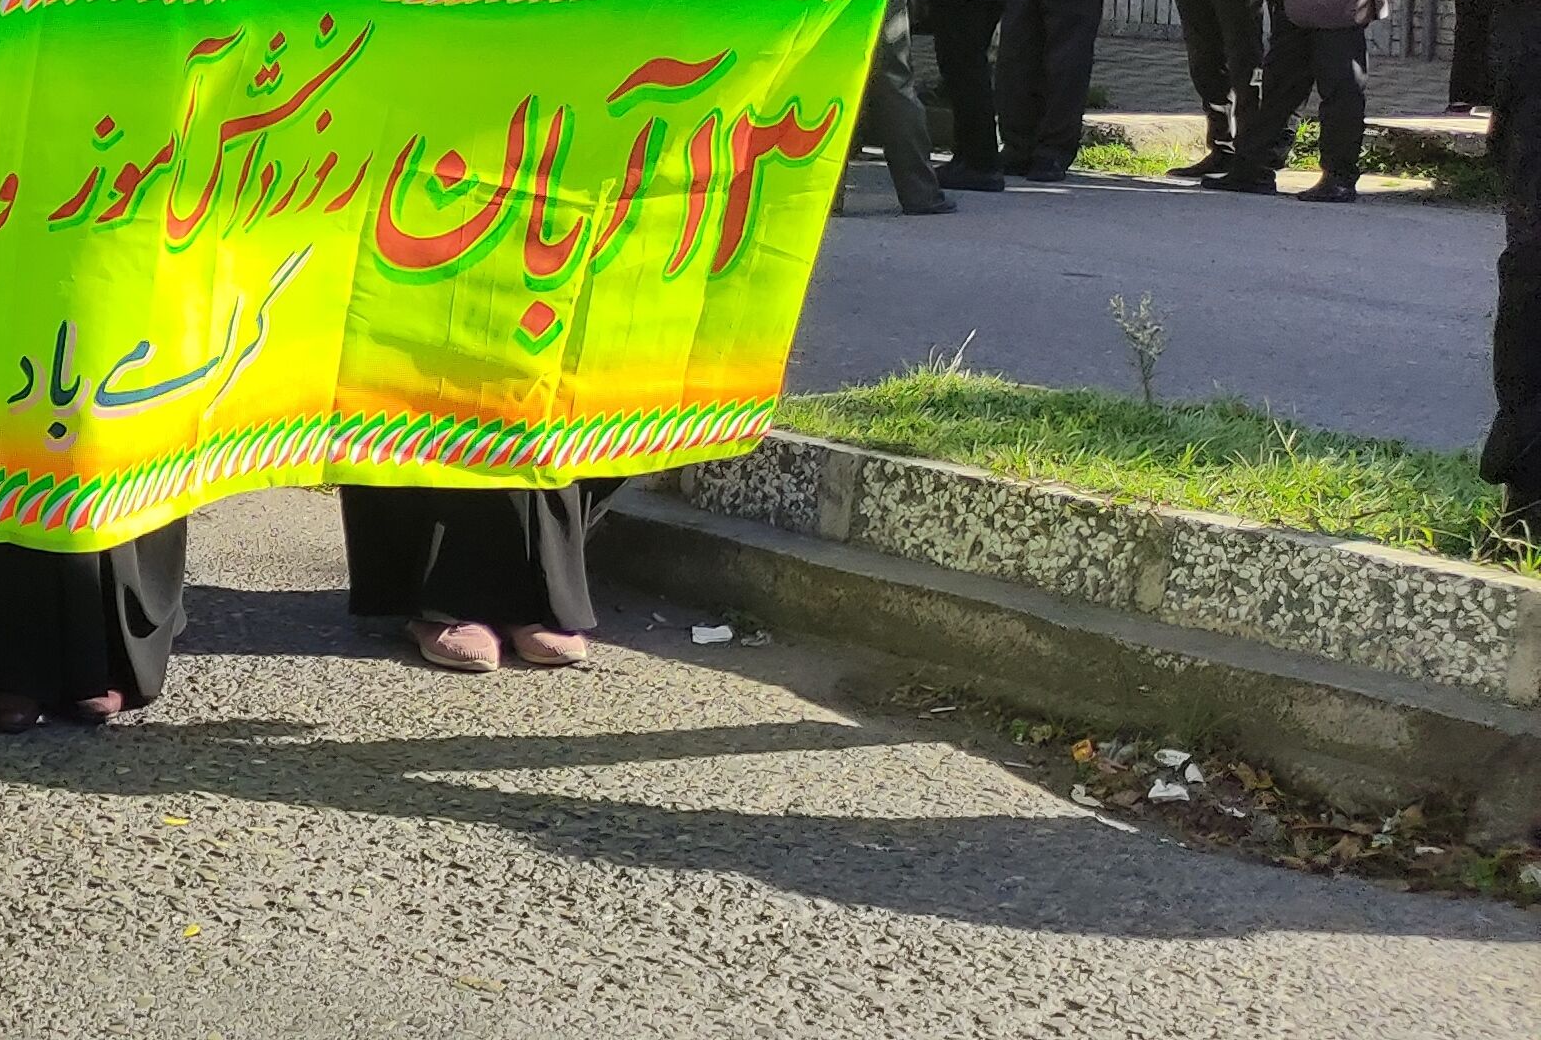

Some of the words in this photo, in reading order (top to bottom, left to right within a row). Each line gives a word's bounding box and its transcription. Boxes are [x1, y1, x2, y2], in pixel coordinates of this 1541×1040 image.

[47, 26, 247, 232] آموز
[165, 12, 374, 251] دانش
[267, 109, 374, 218] روز
[374, 47, 739, 353] آبان
[663, 96, 844, 279] ۱۳
[7, 320, 90, 452] باد
[92, 243, 314, 420] گرامی
